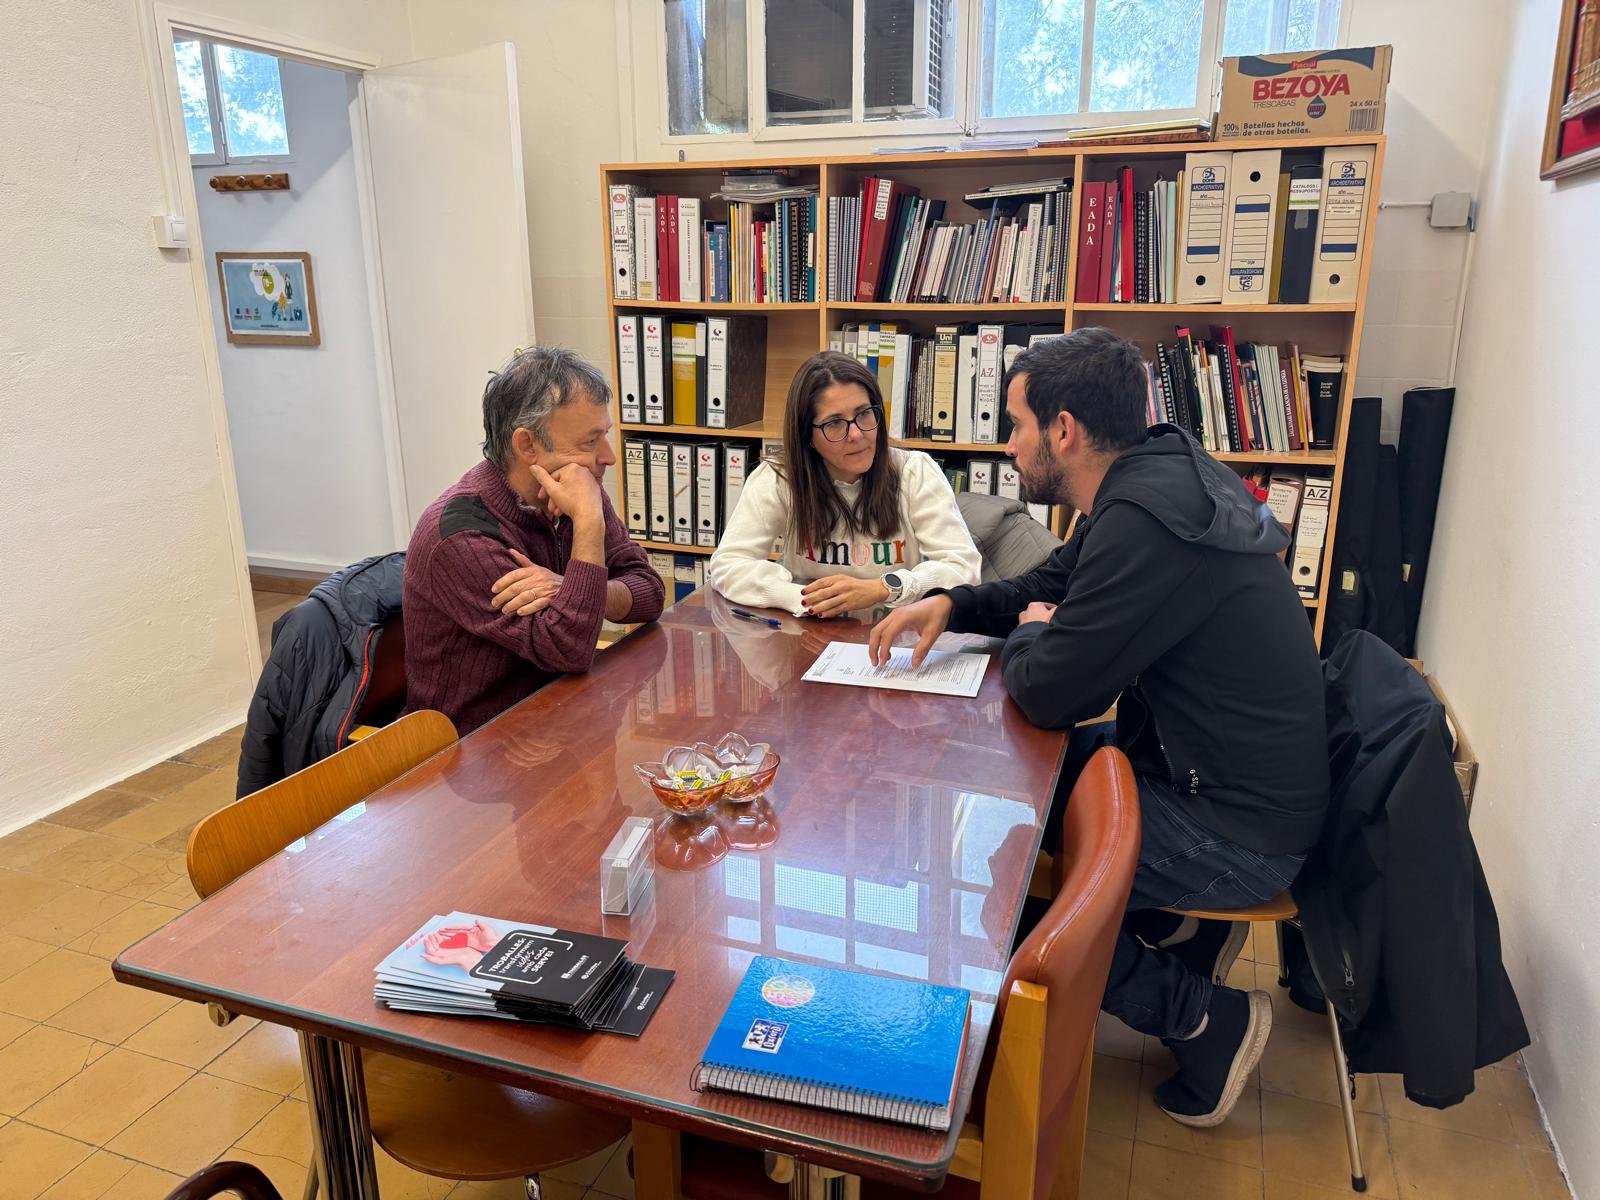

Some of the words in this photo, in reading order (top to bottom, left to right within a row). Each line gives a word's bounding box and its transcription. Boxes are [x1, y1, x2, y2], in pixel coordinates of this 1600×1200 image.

[1252, 73, 1351, 101] BEZOYA
[1253, 100, 1296, 109] TRESCASAS
[1223, 123, 1239, 131] 100%
[1243, 122, 1275, 130] Botellas
[1277, 120, 1305, 128] hechas
[1086, 197, 1097, 246] EADA
[981, 368, 995, 377] A-Z
[627, 450, 643, 459] A/Z
[652, 452, 667, 460] A/Z
[1306, 488, 1328, 498] A/Z
